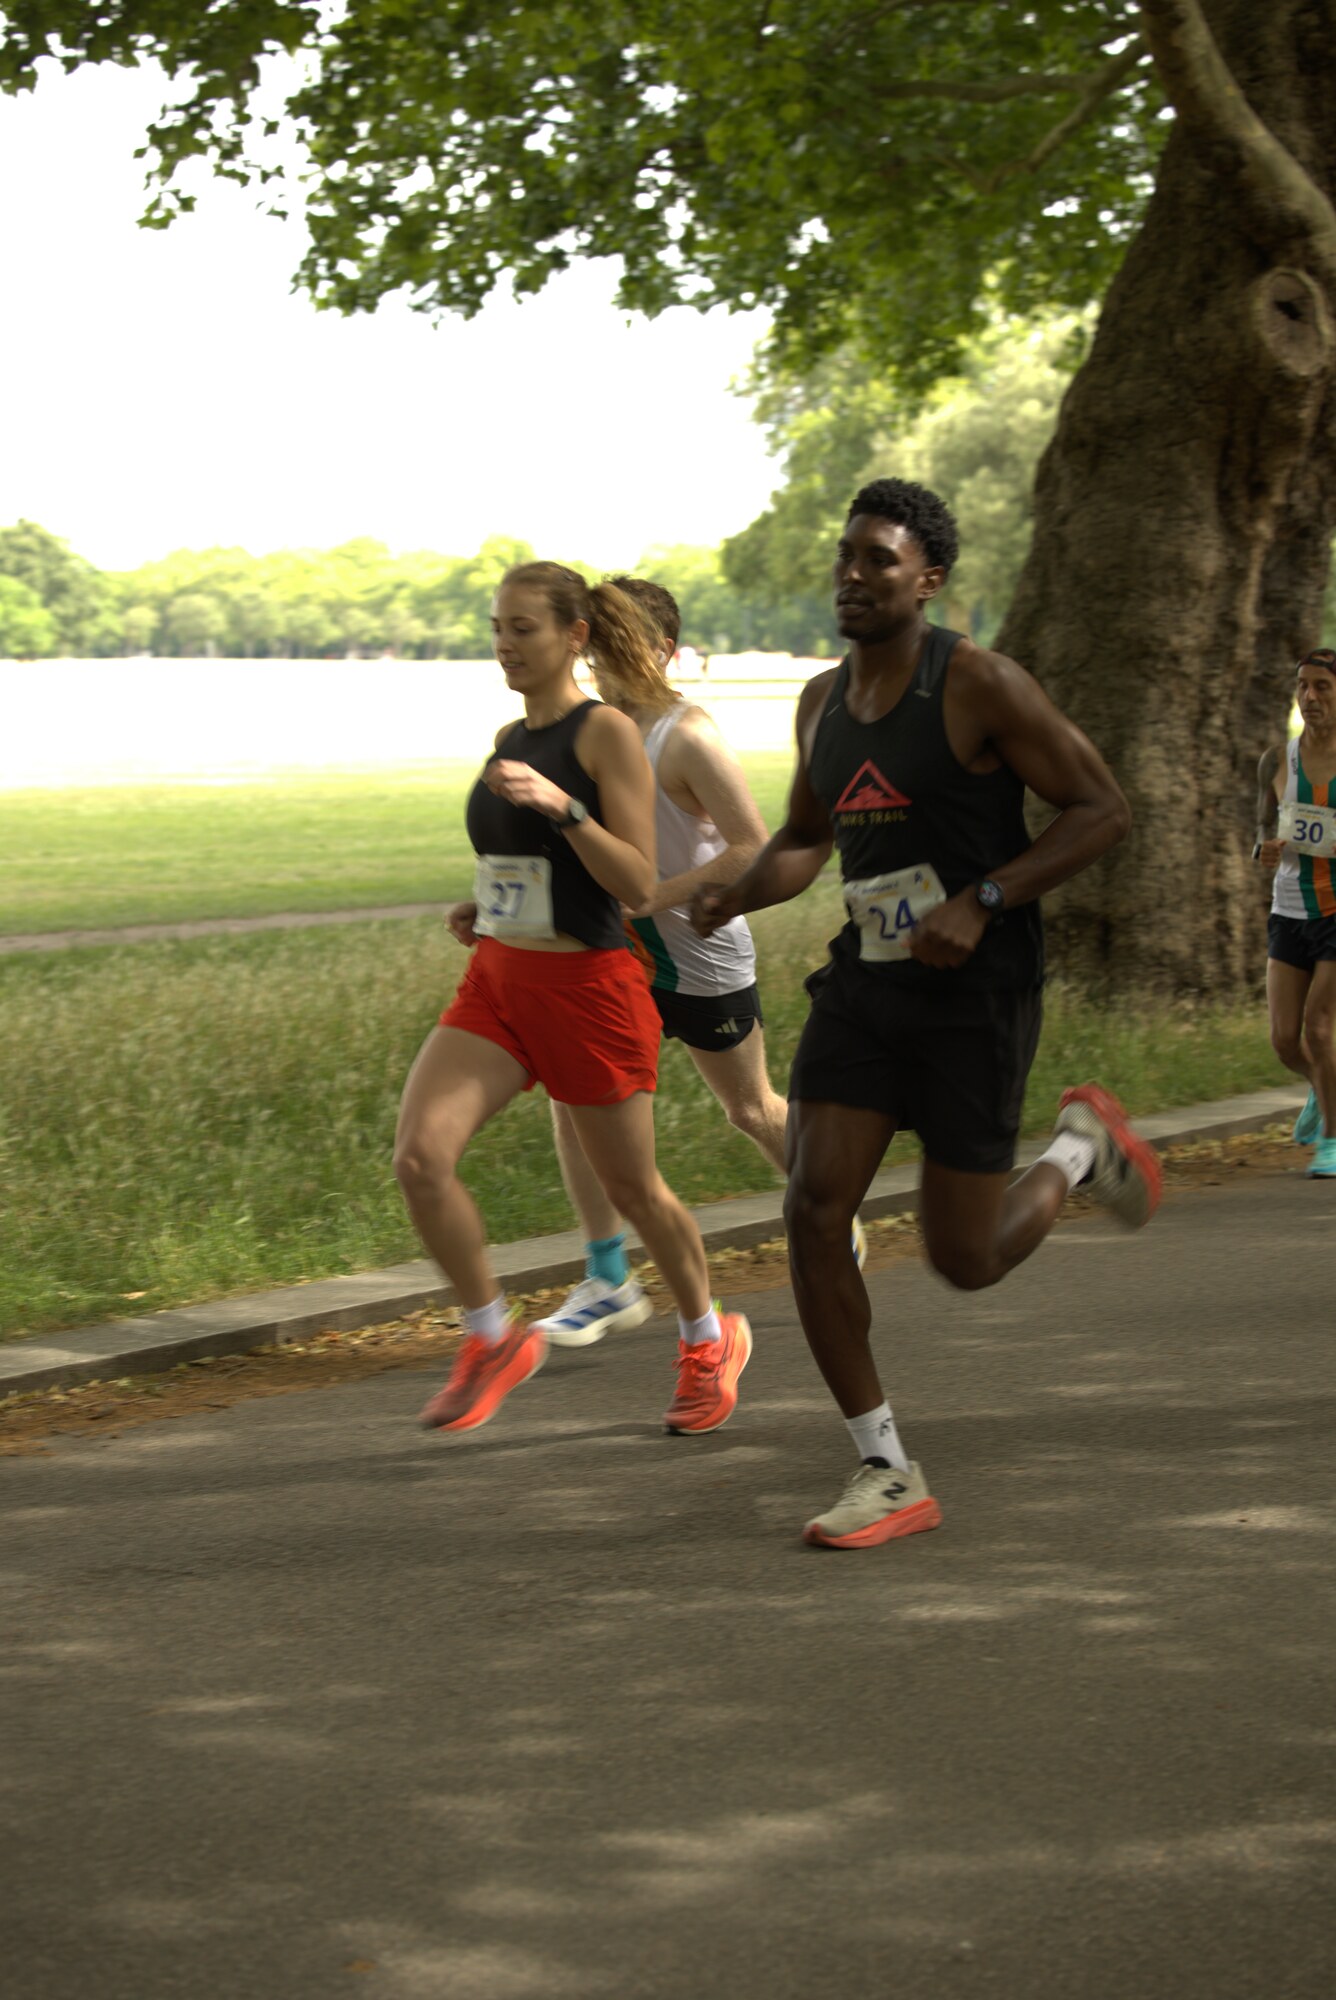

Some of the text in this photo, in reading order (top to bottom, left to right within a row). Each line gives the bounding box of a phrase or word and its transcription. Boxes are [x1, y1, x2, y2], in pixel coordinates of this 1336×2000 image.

[868, 809, 908, 825] TRAIL
[1292, 819, 1324, 844] 30
[490, 881, 525, 918] 27
[868, 897, 918, 939] 24
